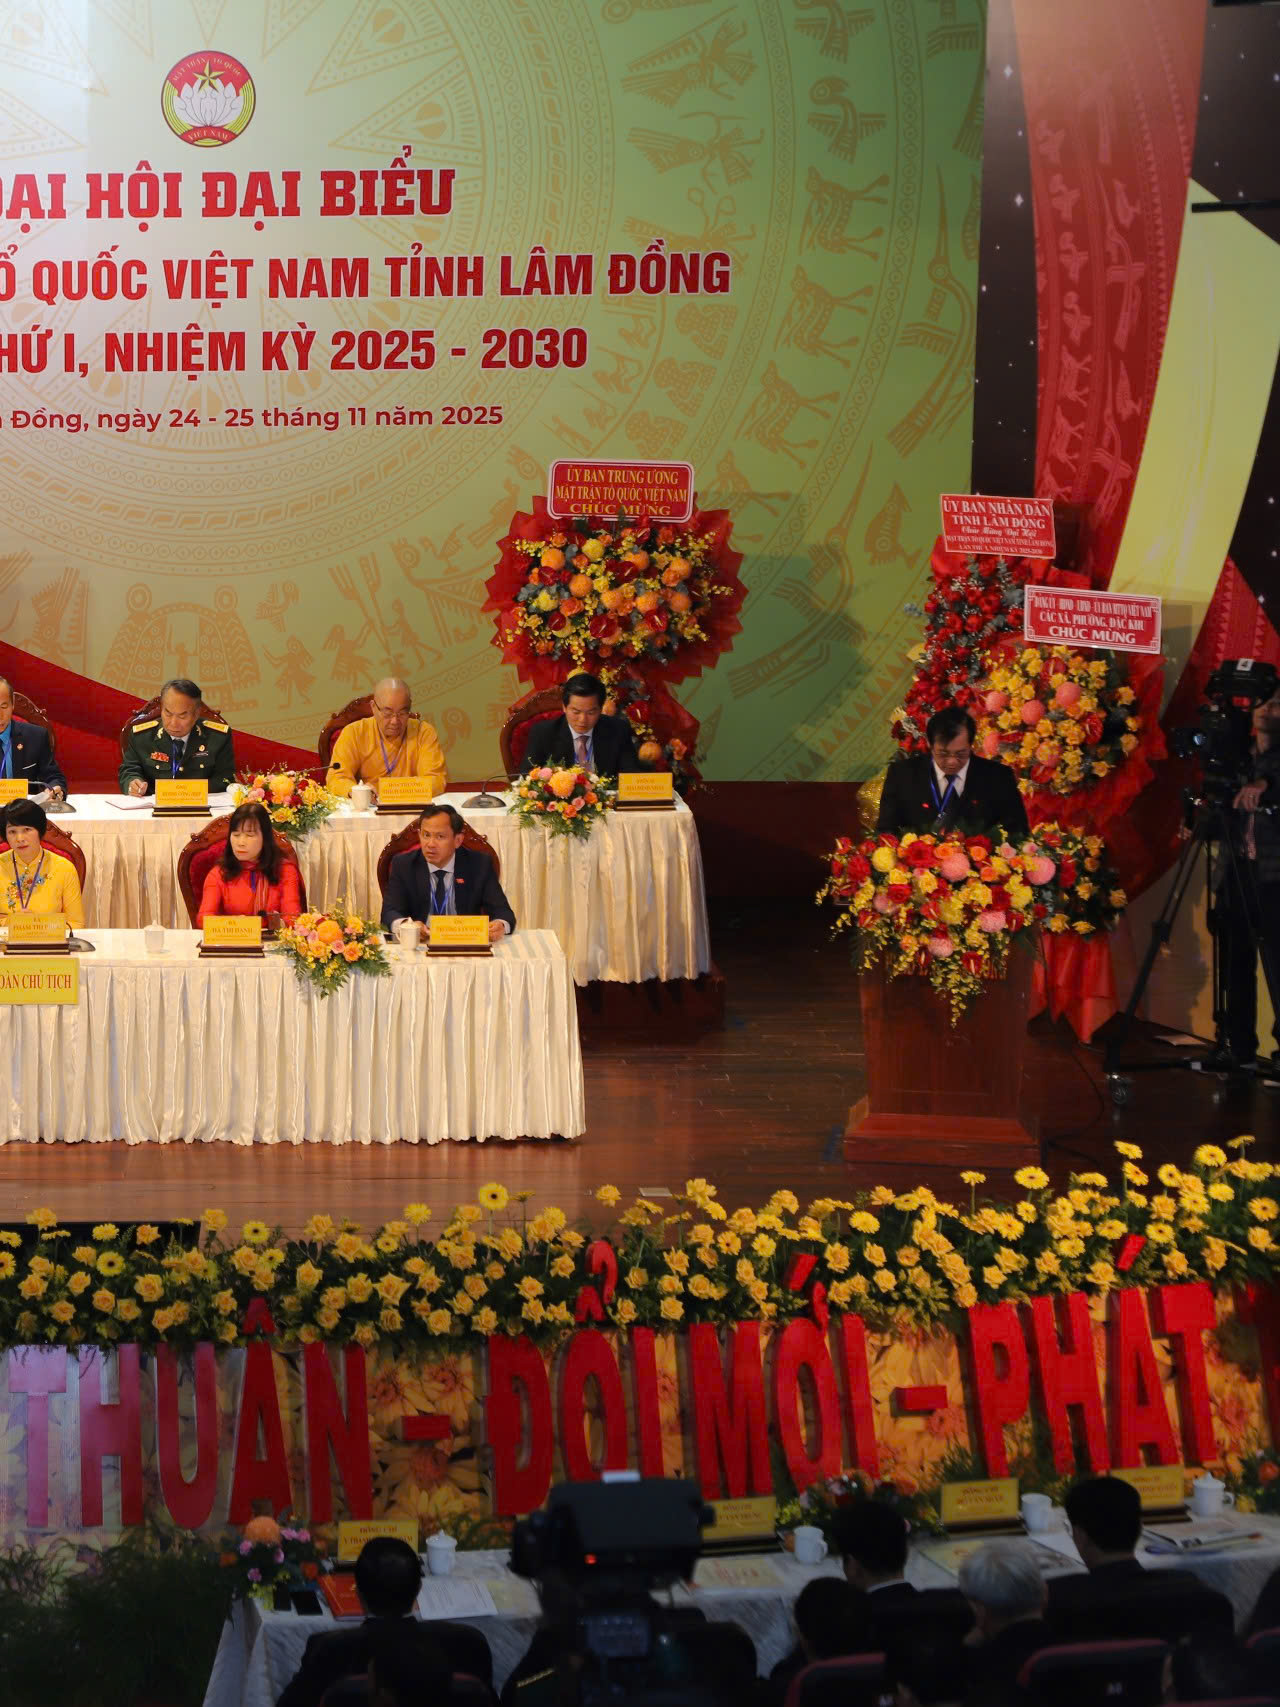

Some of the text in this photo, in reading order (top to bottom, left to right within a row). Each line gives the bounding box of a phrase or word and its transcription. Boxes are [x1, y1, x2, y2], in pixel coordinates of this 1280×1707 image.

[85, 160, 182, 231] HỘI
[202, 170, 301, 231] ĐẠI
[319, 146, 455, 217] BIỂU
[32, 244, 148, 306] QUỐC
[162, 249, 255, 309] VIỆT
[268, 257, 369, 300] NAM
[384, 242, 484, 297] TỈNH
[500, 246, 593, 297] LÂM
[607, 239, 730, 295] ĐỒNG
[63, 332, 89, 378] I,
[103, 323, 246, 382] NHIỆM
[261, 322, 317, 372] KỲ
[330, 329, 437, 371] 2025
[481, 327, 588, 369] 2030
[10, 407, 89, 433] Đồng,
[97, 408, 163, 433] ngày
[169, 409, 201, 428] 24
[224, 408, 254, 427] 25
[261, 407, 340, 431] tháng
[347, 407, 366, 426] 11
[375, 406, 433, 426] năm
[441, 406, 503, 425] 2025
[583, 469, 605, 483] BAN
[607, 469, 645, 484] TRUNG
[666, 489, 689, 503] NAM
[570, 501, 671, 516] CHÚC MỪNG
[962, 500, 986, 513] BAN
[988, 499, 1023, 515] NHÂN
[951, 512, 981, 525] TỈNH
[983, 513, 1010, 527] LÂM
[1039, 609, 1056, 623] CÁC
[1048, 624, 1137, 644] CHÚC MỪNG
[21, 969, 44, 989] CHỦ
[46, 974, 72, 992] TỊCH
[486, 1240, 665, 1516] ĐỔI
[688, 1252, 881, 1501] MỚI
[969, 1233, 1218, 1478] PHÁT
